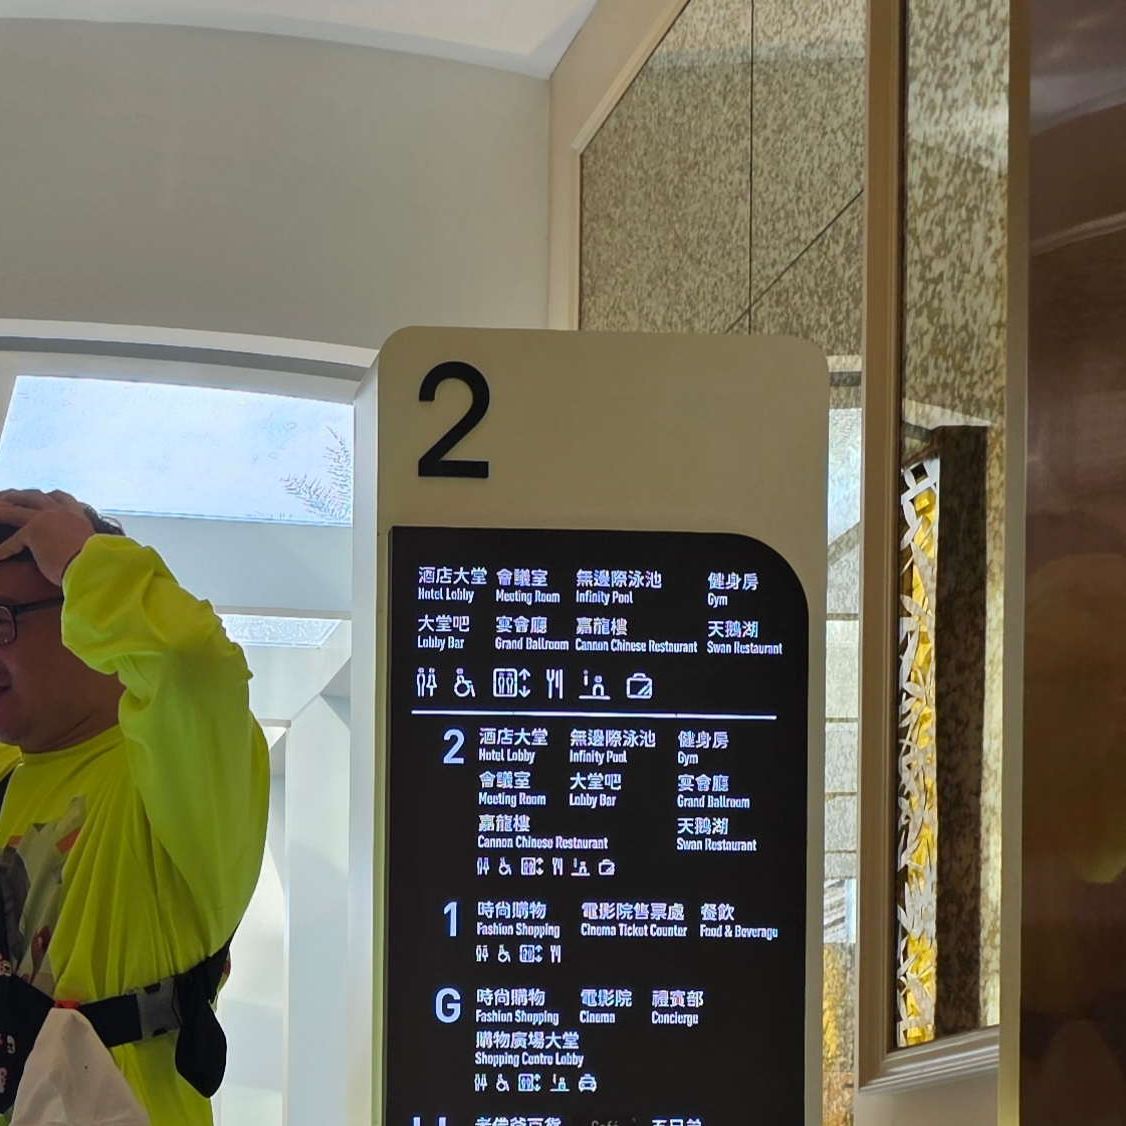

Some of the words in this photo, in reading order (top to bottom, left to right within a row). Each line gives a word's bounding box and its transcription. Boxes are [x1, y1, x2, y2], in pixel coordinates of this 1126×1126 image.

[418, 360, 491, 478] 2
[419, 566, 487, 584] 酒店大堂
[496, 569, 548, 586] 會議室
[708, 572, 759, 590] 健身房
[418, 587, 443, 600] Hotel
[446, 588, 474, 603] Lobby
[496, 589, 532, 605] Meeting
[535, 590, 560, 603] Room
[576, 590, 610, 606] Infinity
[613, 591, 633, 604] Pool
[708, 593, 728, 608] Gym
[418, 614, 470, 632] 大堂吧
[708, 620, 758, 638] 天鵝湖
[418, 636, 445, 651] Lobby
[448, 637, 464, 648] Bar
[495, 637, 523, 650] Grand
[526, 637, 569, 650] Ballroom
[576, 638, 608, 651] Cannon
[611, 639, 646, 652] Chinese
[649, 640, 697, 653] Restaurant
[707, 640, 731, 653] Swan
[734, 641, 782, 655] Restaurant
[479, 728, 548, 745] 酒店大堂
[678, 730, 729, 749] 健身房
[443, 729, 465, 764] 2
[479, 749, 504, 761] Hotel
[507, 749, 535, 764] Lobby
[570, 750, 604, 765] Infinity
[607, 751, 627, 763] Pool
[678, 751, 698, 766] Gym
[479, 771, 531, 789] 會議室
[570, 773, 621, 790] 大堂吧
[479, 792, 516, 807] Meeting
[519, 793, 546, 805] Room
[569, 794, 597, 809] Lobby
[600, 794, 616, 806] Bar
[677, 795, 705, 807] Grand
[707, 795, 750, 808] Ballroom
[677, 817, 728, 835] 天鵝湖
[478, 835, 513, 848] Cannon
[515, 836, 553, 849] Chinese
[556, 836, 608, 849] Restaurant
[677, 838, 702, 850] Swan
[705, 839, 757, 851] Restaurant
[477, 901, 546, 919] 時尚購物
[701, 903, 734, 921] 餐飲
[443, 902, 458, 937] 1
[476, 923, 513, 935] Fashion
[516, 923, 560, 938] Shopping
[581, 924, 616, 936] Cinema
[618, 924, 648, 937] Ticket
[650, 925, 687, 937] Counter
[700, 925, 722, 938] Food
[724, 926, 732, 937] &
[735, 925, 778, 940] Beverage
[436, 988, 461, 1023] G
[476, 989, 545, 1006] 時尚購物
[581, 989, 632, 1007] 電影院
[476, 1010, 512, 1023] Fashion
[515, 1010, 559, 1025] Shopping
[580, 1010, 615, 1023] Cinema
[652, 1011, 698, 1026] Concierge
[476, 1031, 580, 1049] 購物廣場大堂
[475, 1053, 519, 1068] Shopping
[522, 1053, 553, 1065] Centre
[555, 1053, 584, 1068] Lobby
